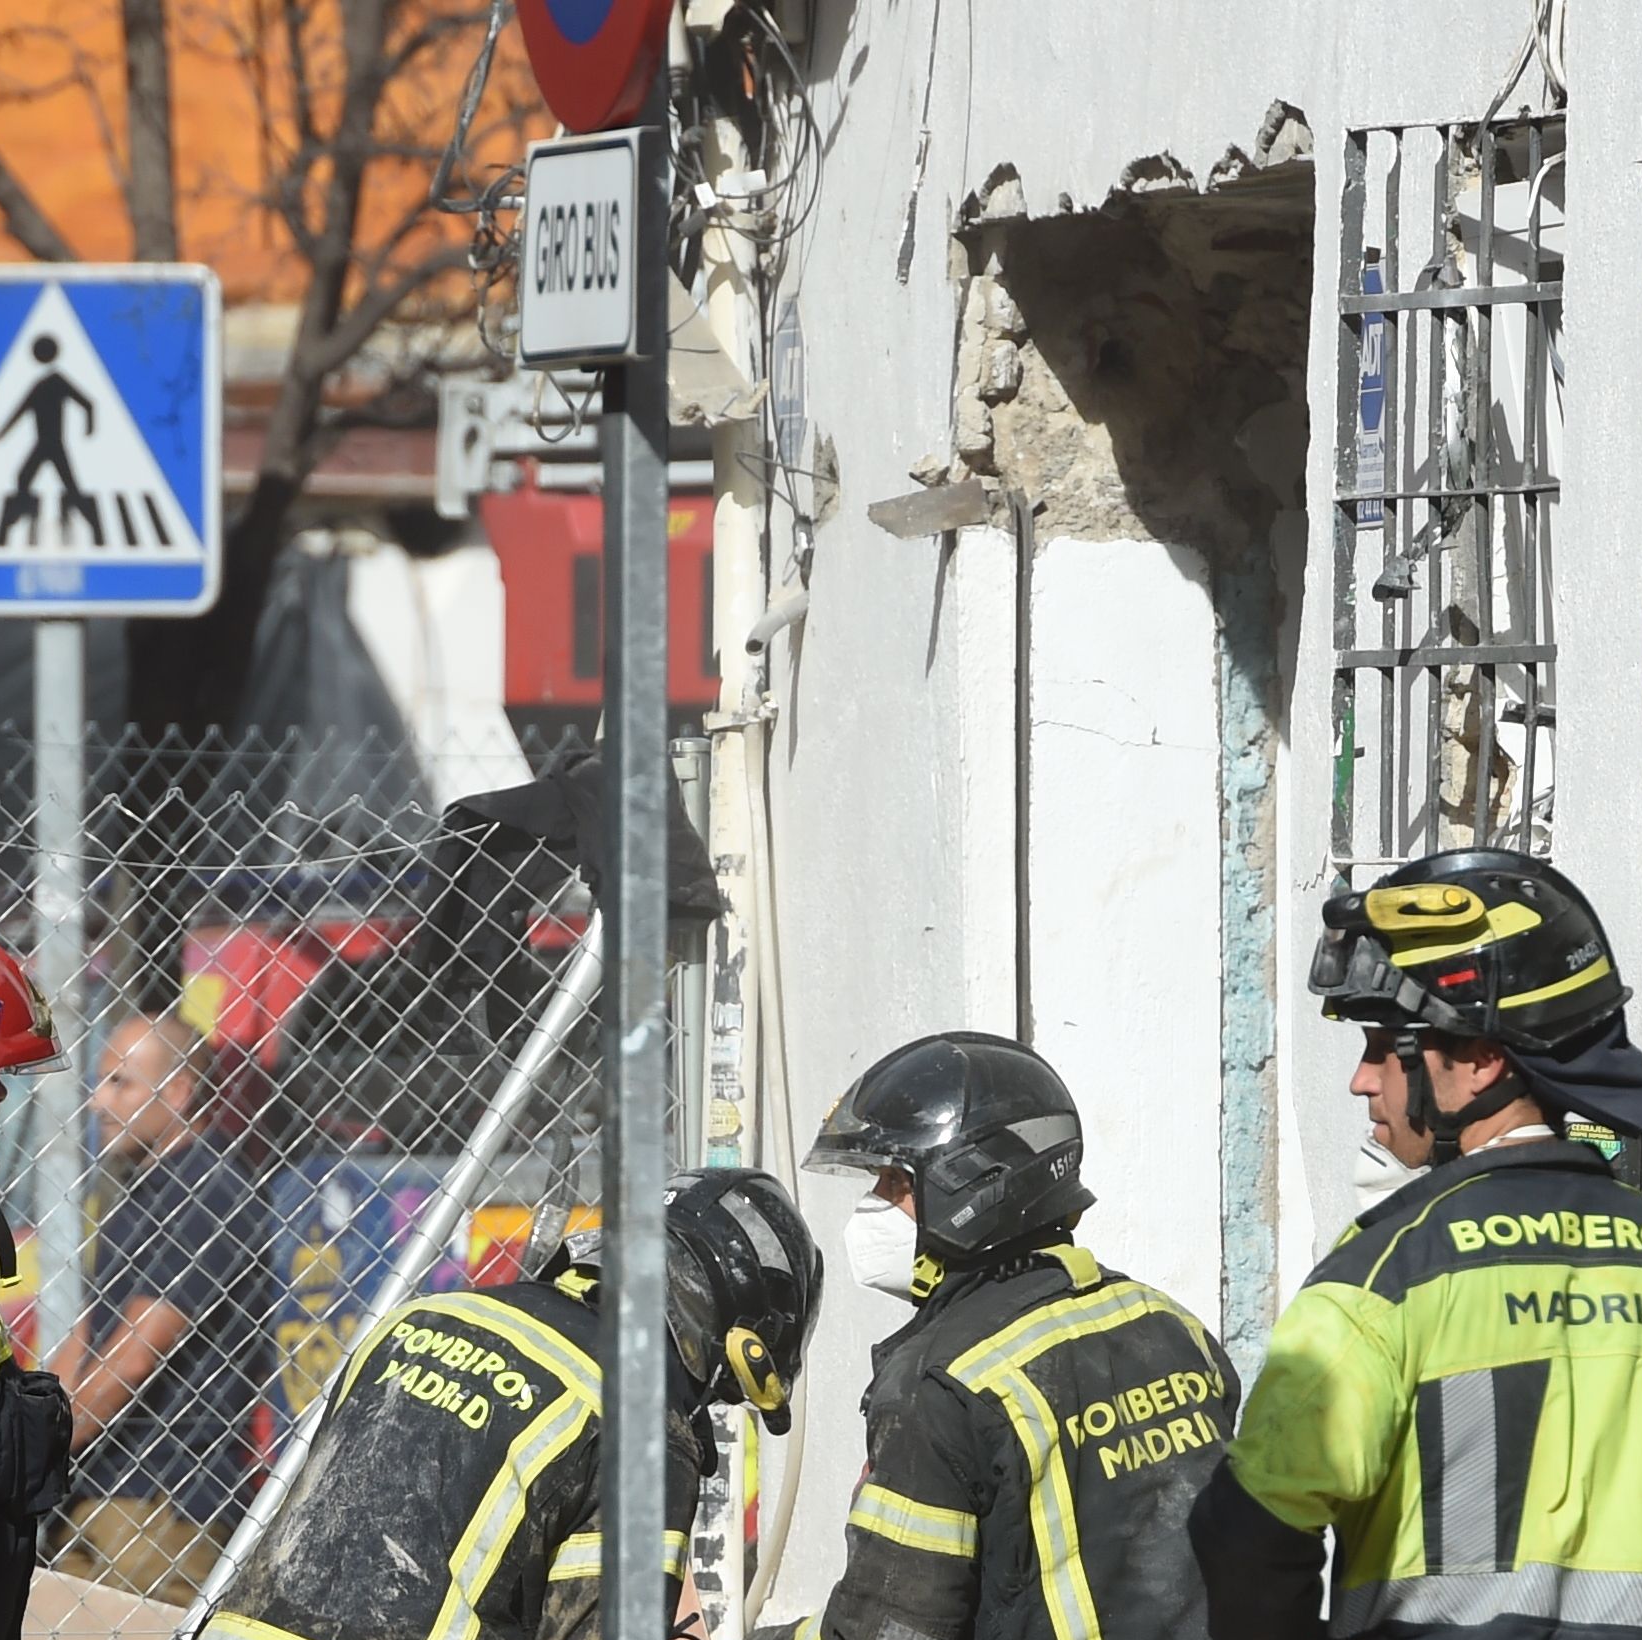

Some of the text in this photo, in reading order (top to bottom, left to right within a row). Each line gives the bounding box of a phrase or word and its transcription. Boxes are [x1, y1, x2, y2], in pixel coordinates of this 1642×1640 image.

[535, 198, 620, 296] GIRO BUS
[1361, 323, 1383, 378] ADT
[1097, 1410, 1223, 1481] MADRI
